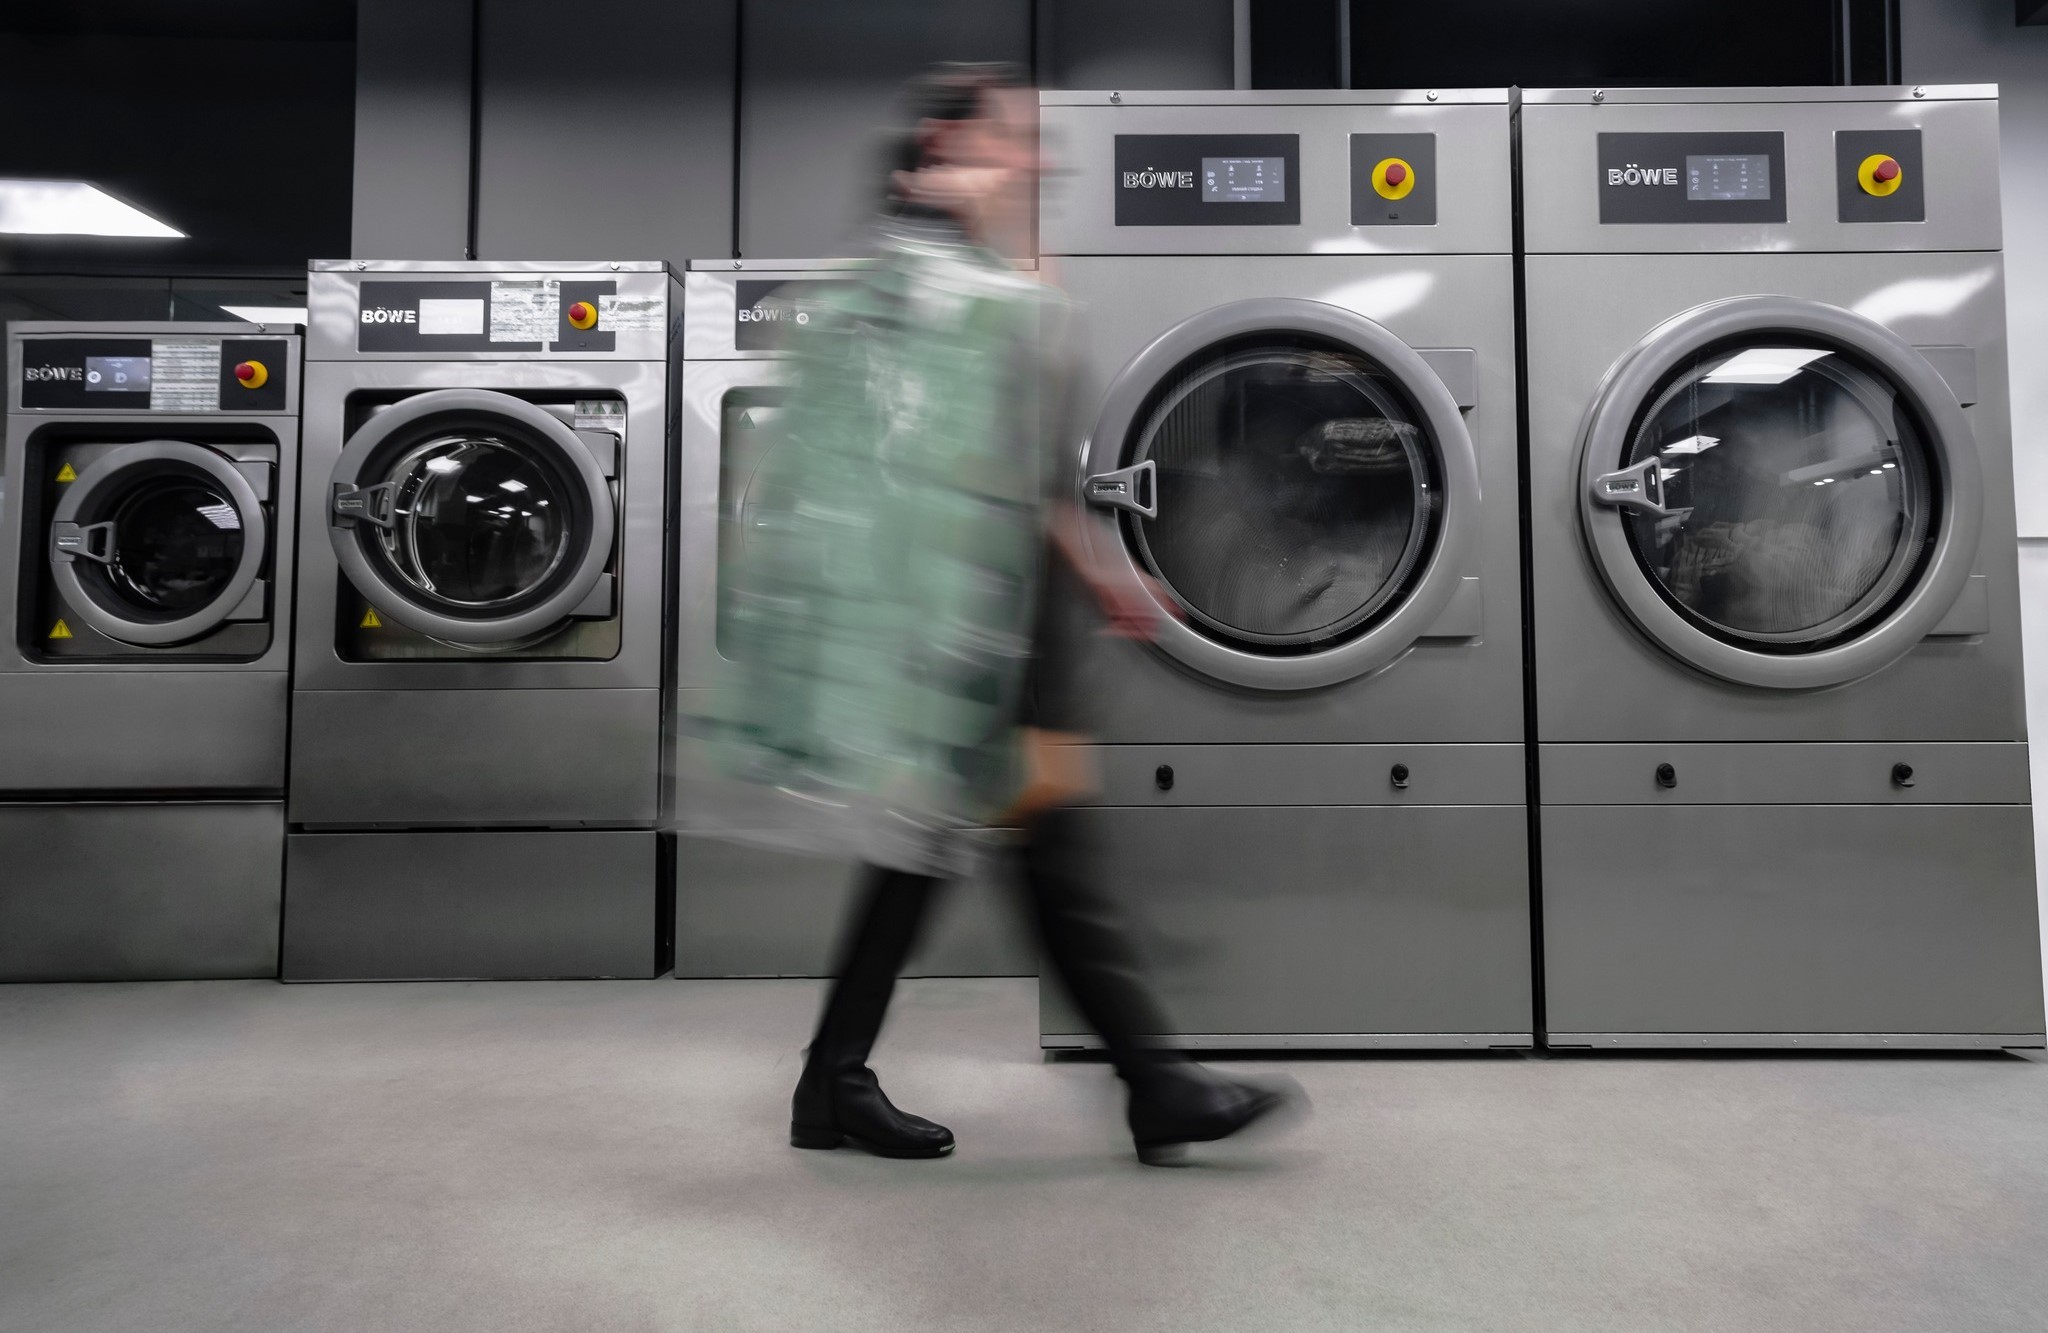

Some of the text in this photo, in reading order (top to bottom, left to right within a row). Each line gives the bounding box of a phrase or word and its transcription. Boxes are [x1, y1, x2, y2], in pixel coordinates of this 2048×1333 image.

[1123, 166, 1193, 188] BÖWE
[1608, 163, 1678, 185] BÖWE
[361, 306, 417, 323] BÖWE
